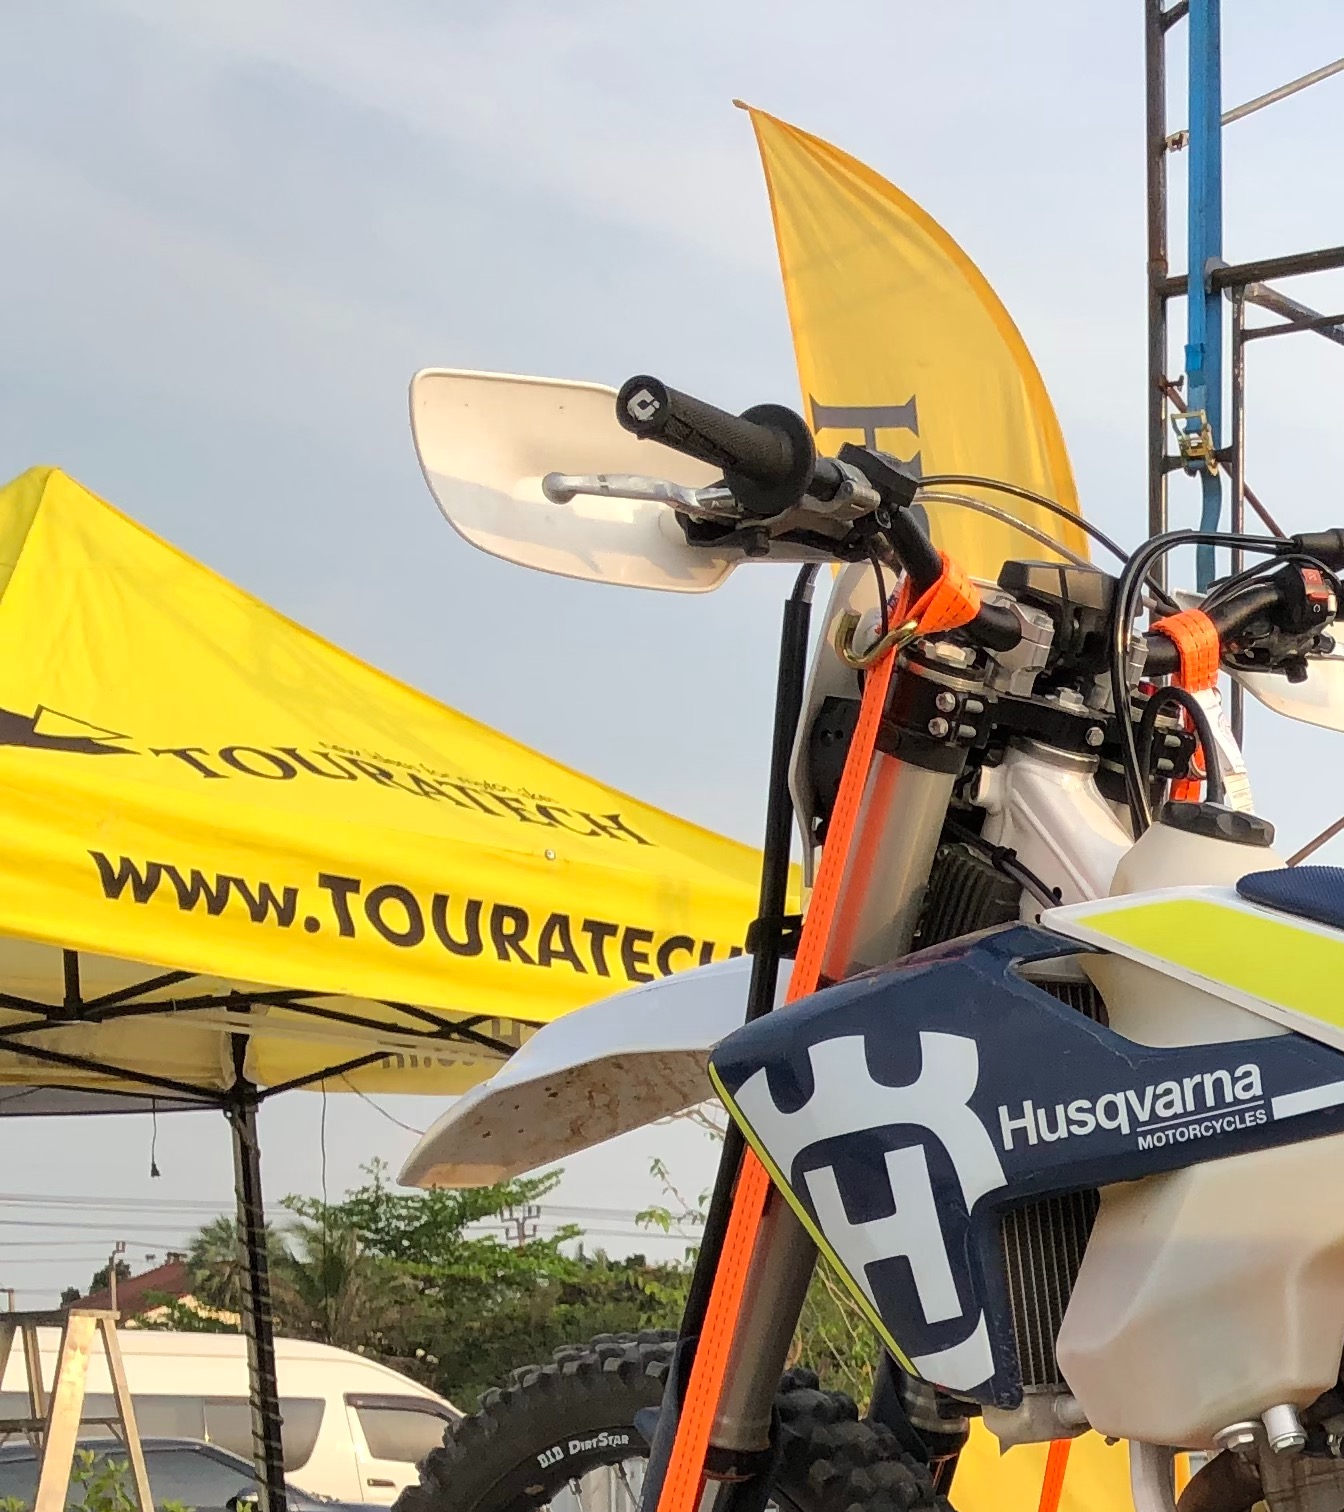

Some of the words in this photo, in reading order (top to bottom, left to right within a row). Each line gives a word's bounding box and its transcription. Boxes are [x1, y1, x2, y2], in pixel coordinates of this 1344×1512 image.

[150, 745, 655, 847] TOURATECH
[998, 1063, 1264, 1150] Husqvarna
[1137, 1110, 1268, 1150] MOTORCYCLES
